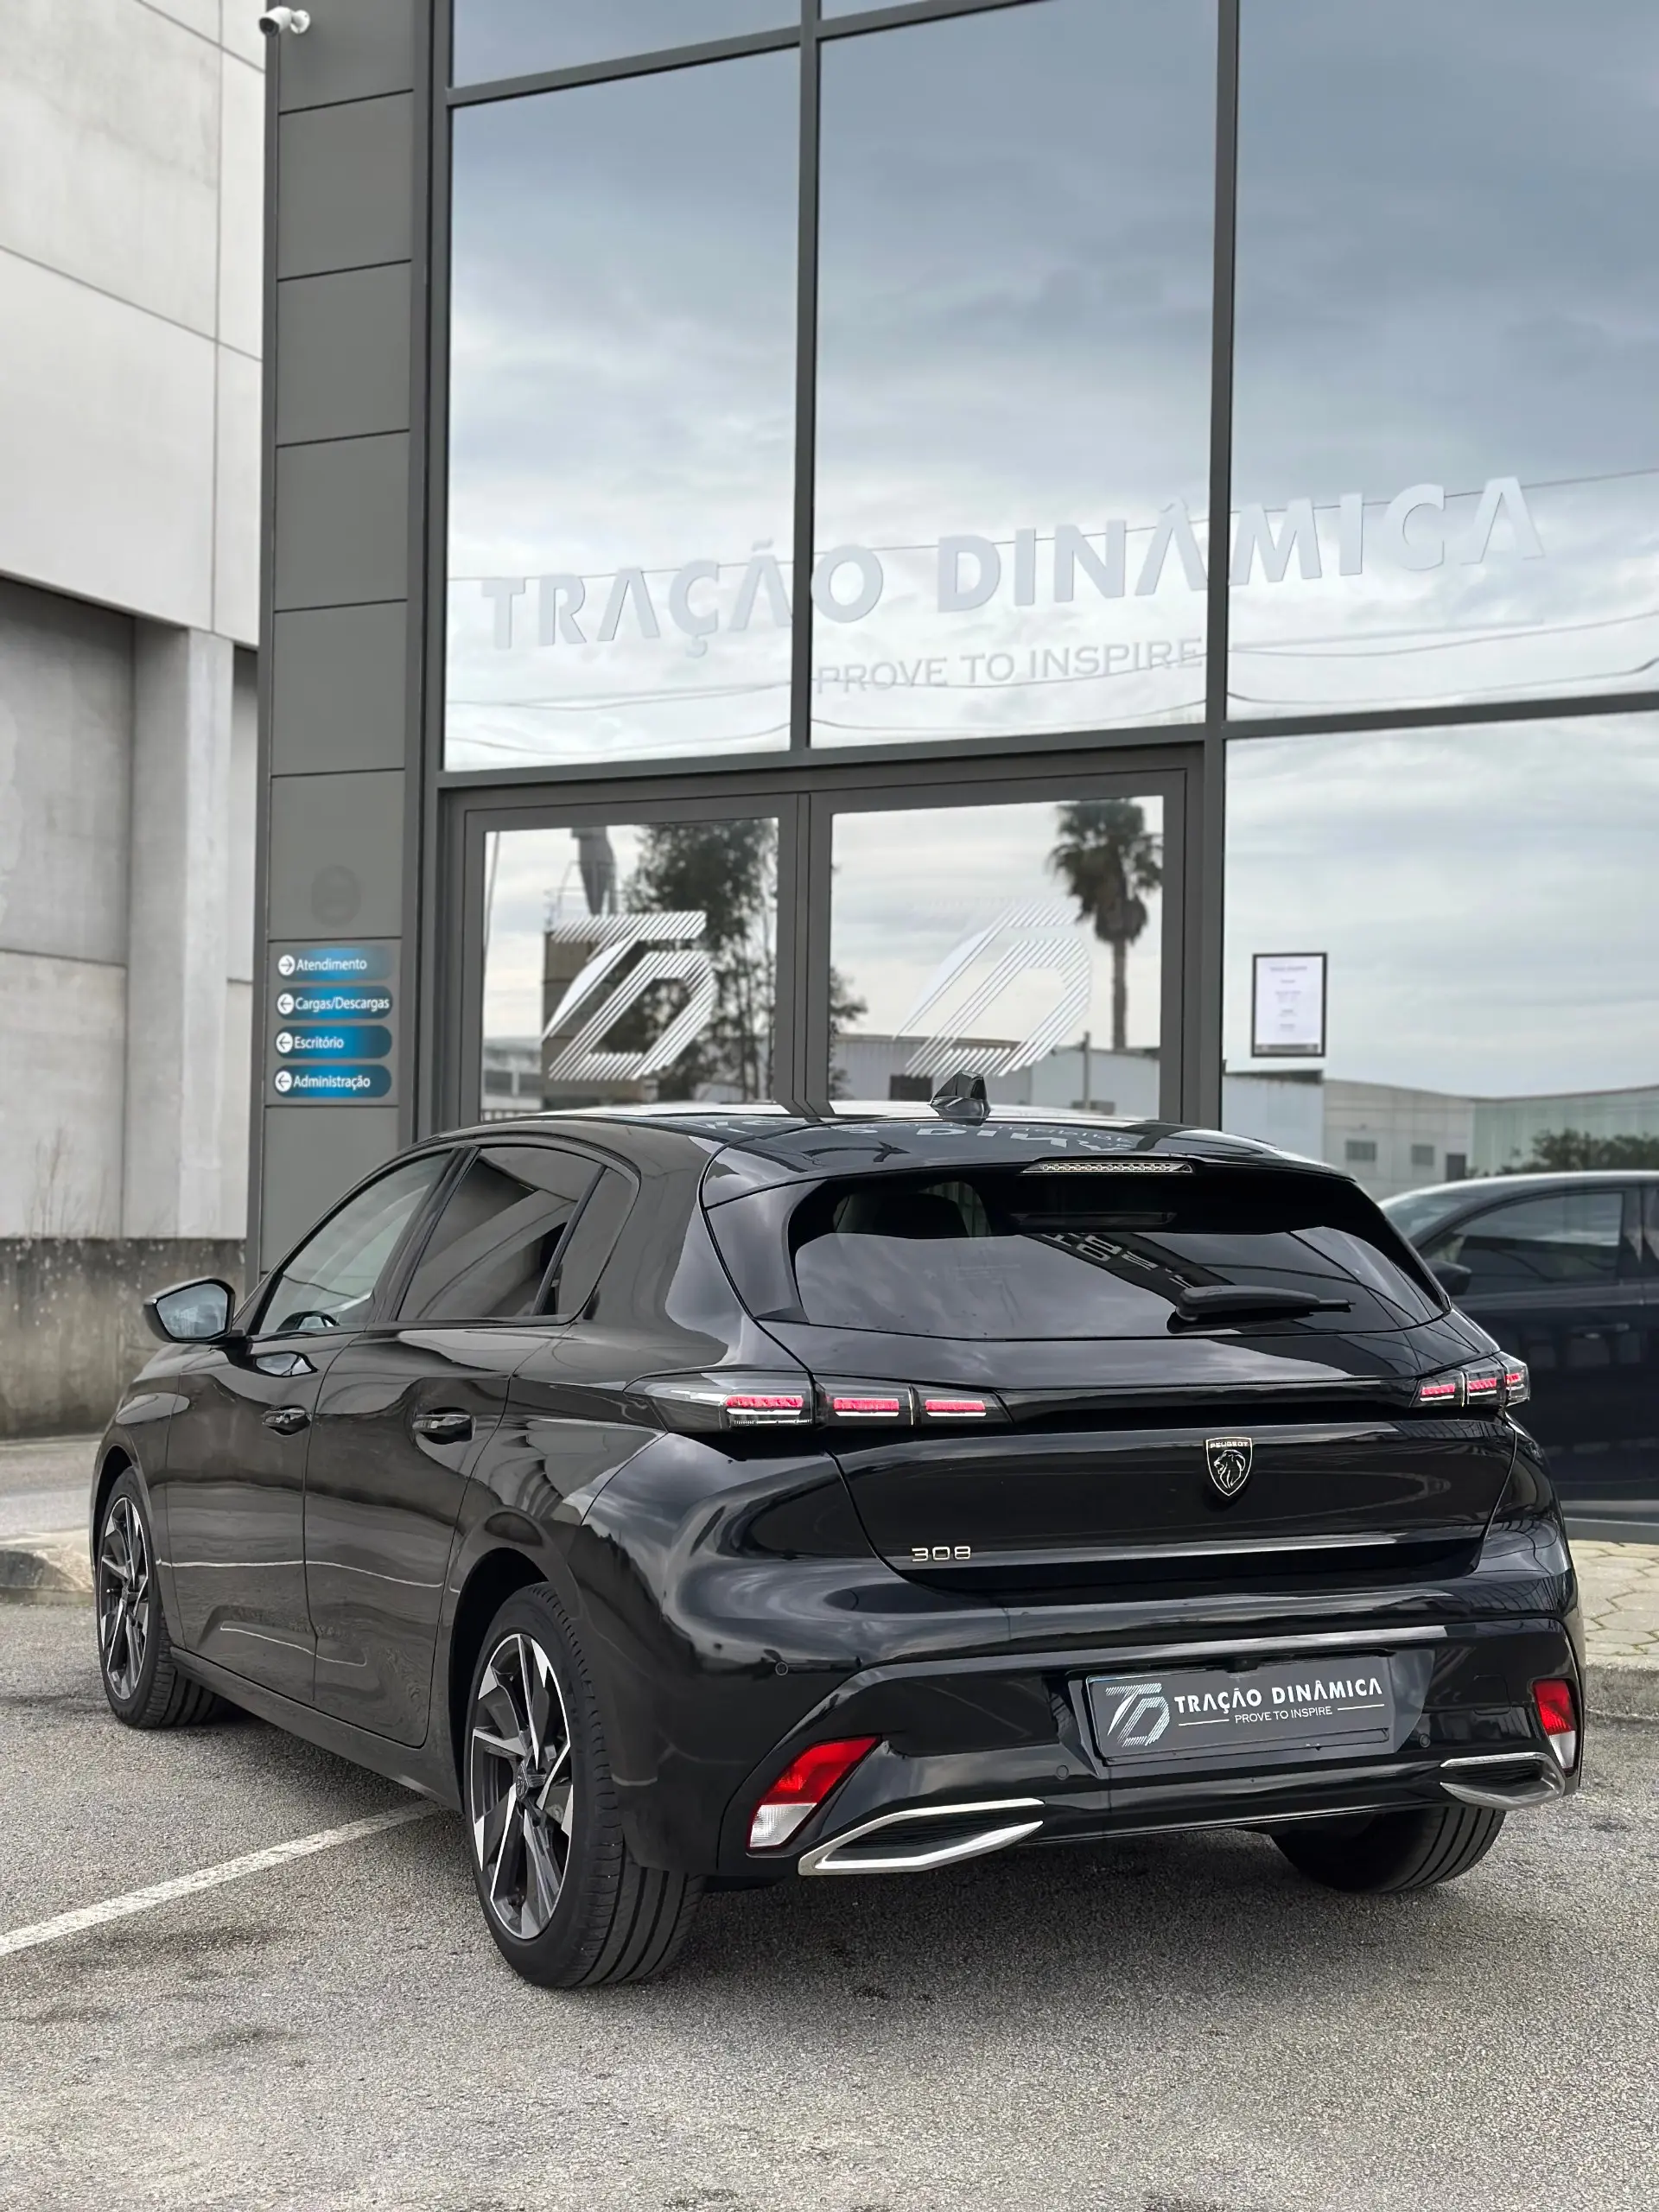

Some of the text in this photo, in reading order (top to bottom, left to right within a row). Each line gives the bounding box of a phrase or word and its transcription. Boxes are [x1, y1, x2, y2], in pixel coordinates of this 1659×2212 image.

[480, 475, 1545, 658] TRAÇÃO DINÂMICA
[817, 636, 1204, 694] PROVE TO INSPIRE
[296, 957, 367, 972] Atendimento
[295, 995, 390, 1013] Cargas/Descargas
[294, 1035, 345, 1050] Escritório
[293, 1074, 371, 1090] Administração
[1210, 1440, 1249, 1449] PEUGEOT
[911, 1545, 971, 1562] 308
[1174, 1677, 1382, 1714] TRAÇÃO DINÂMICA
[1234, 1706, 1332, 1724] PROVE TO INSPIRE
